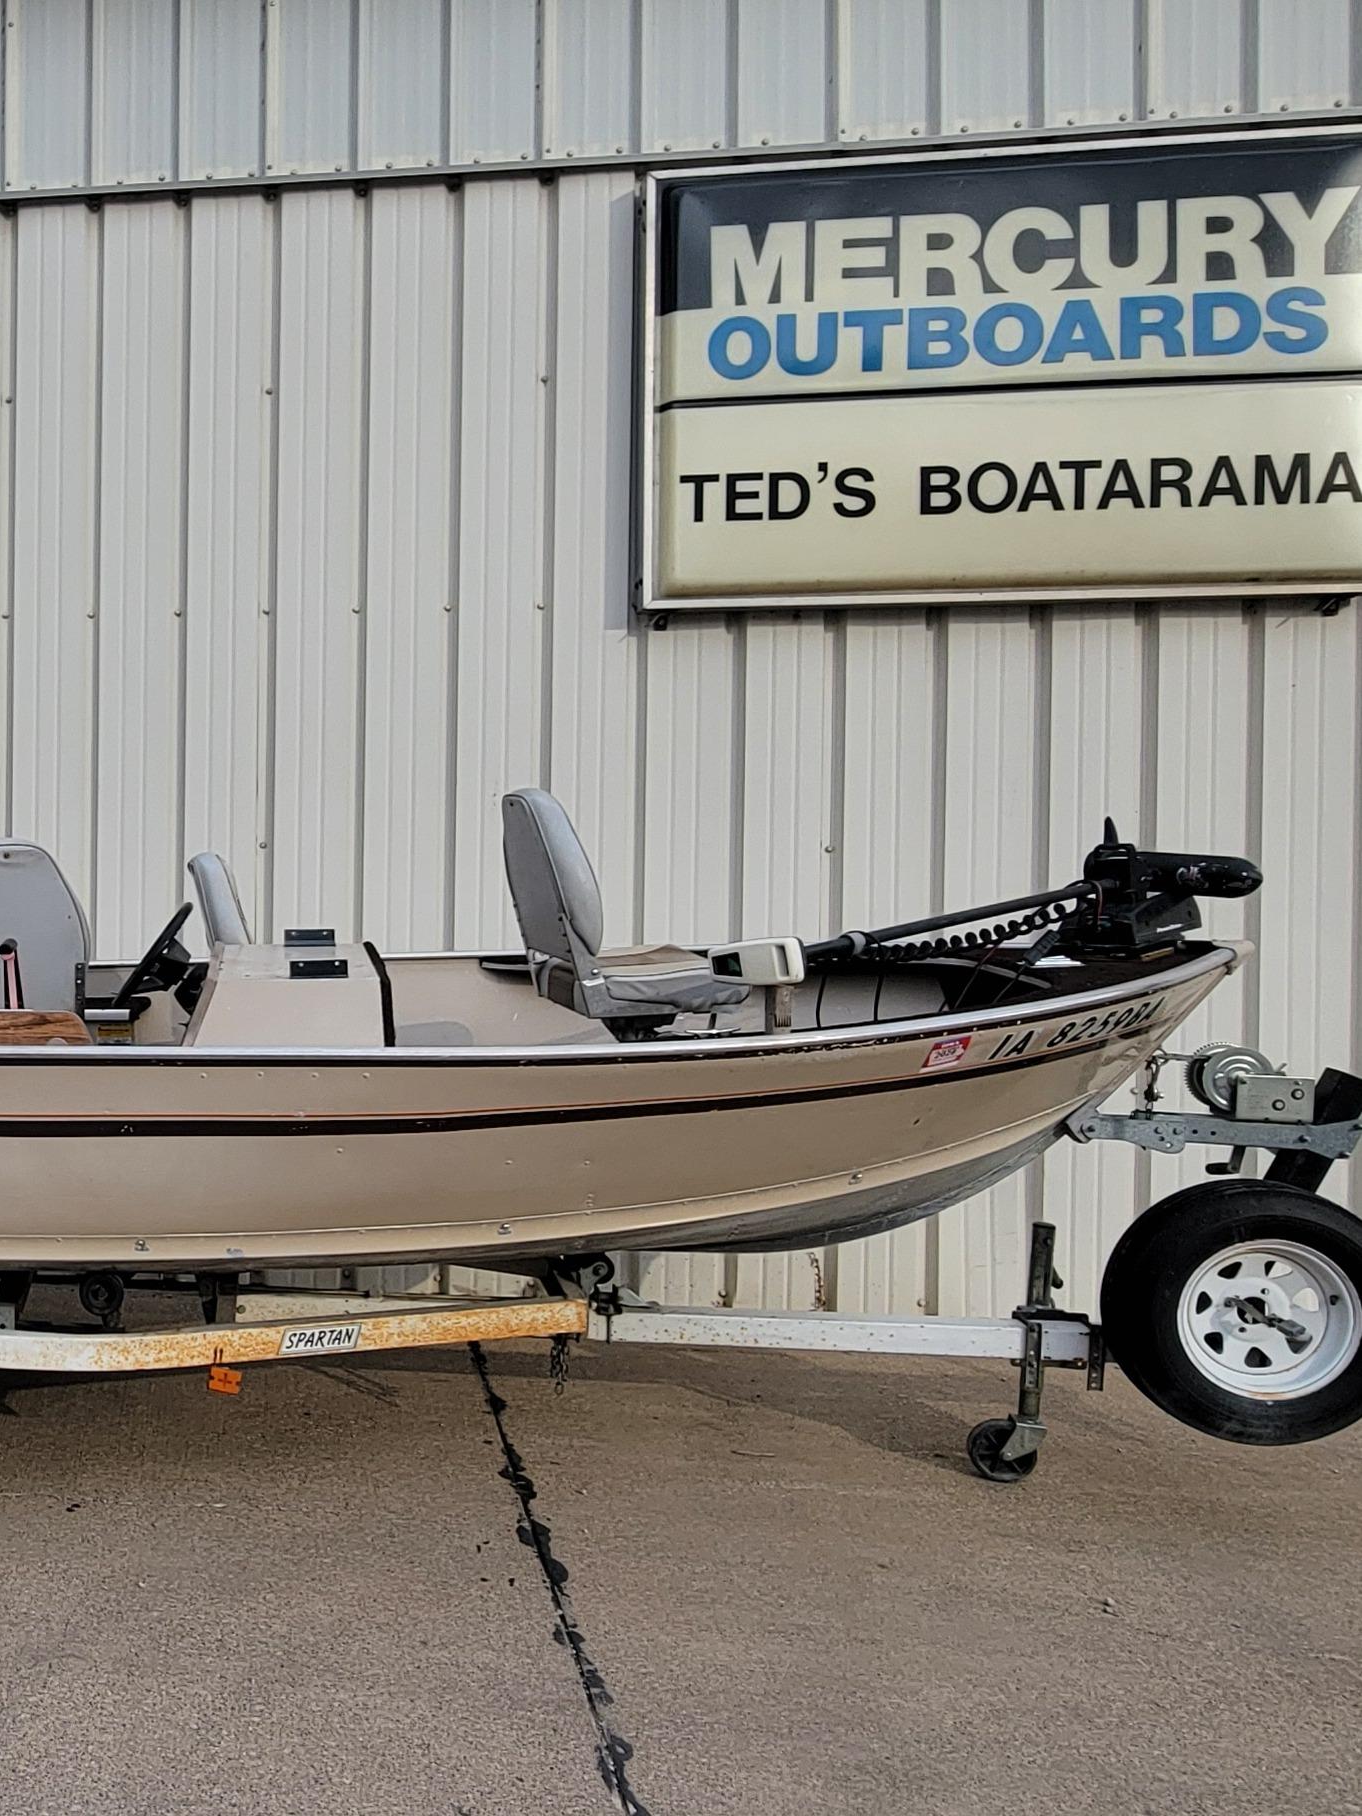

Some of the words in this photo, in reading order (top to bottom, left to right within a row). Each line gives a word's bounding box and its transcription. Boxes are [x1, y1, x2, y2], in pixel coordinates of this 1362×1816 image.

[710, 186, 1361, 309] MERCURY
[707, 286, 1329, 380] OUTBOARDS
[680, 462, 877, 522] TED'S
[919, 452, 1362, 516] BOATARAMA
[987, 1030, 1036, 1060] IA
[285, 1327, 356, 1350] SPARTAN
